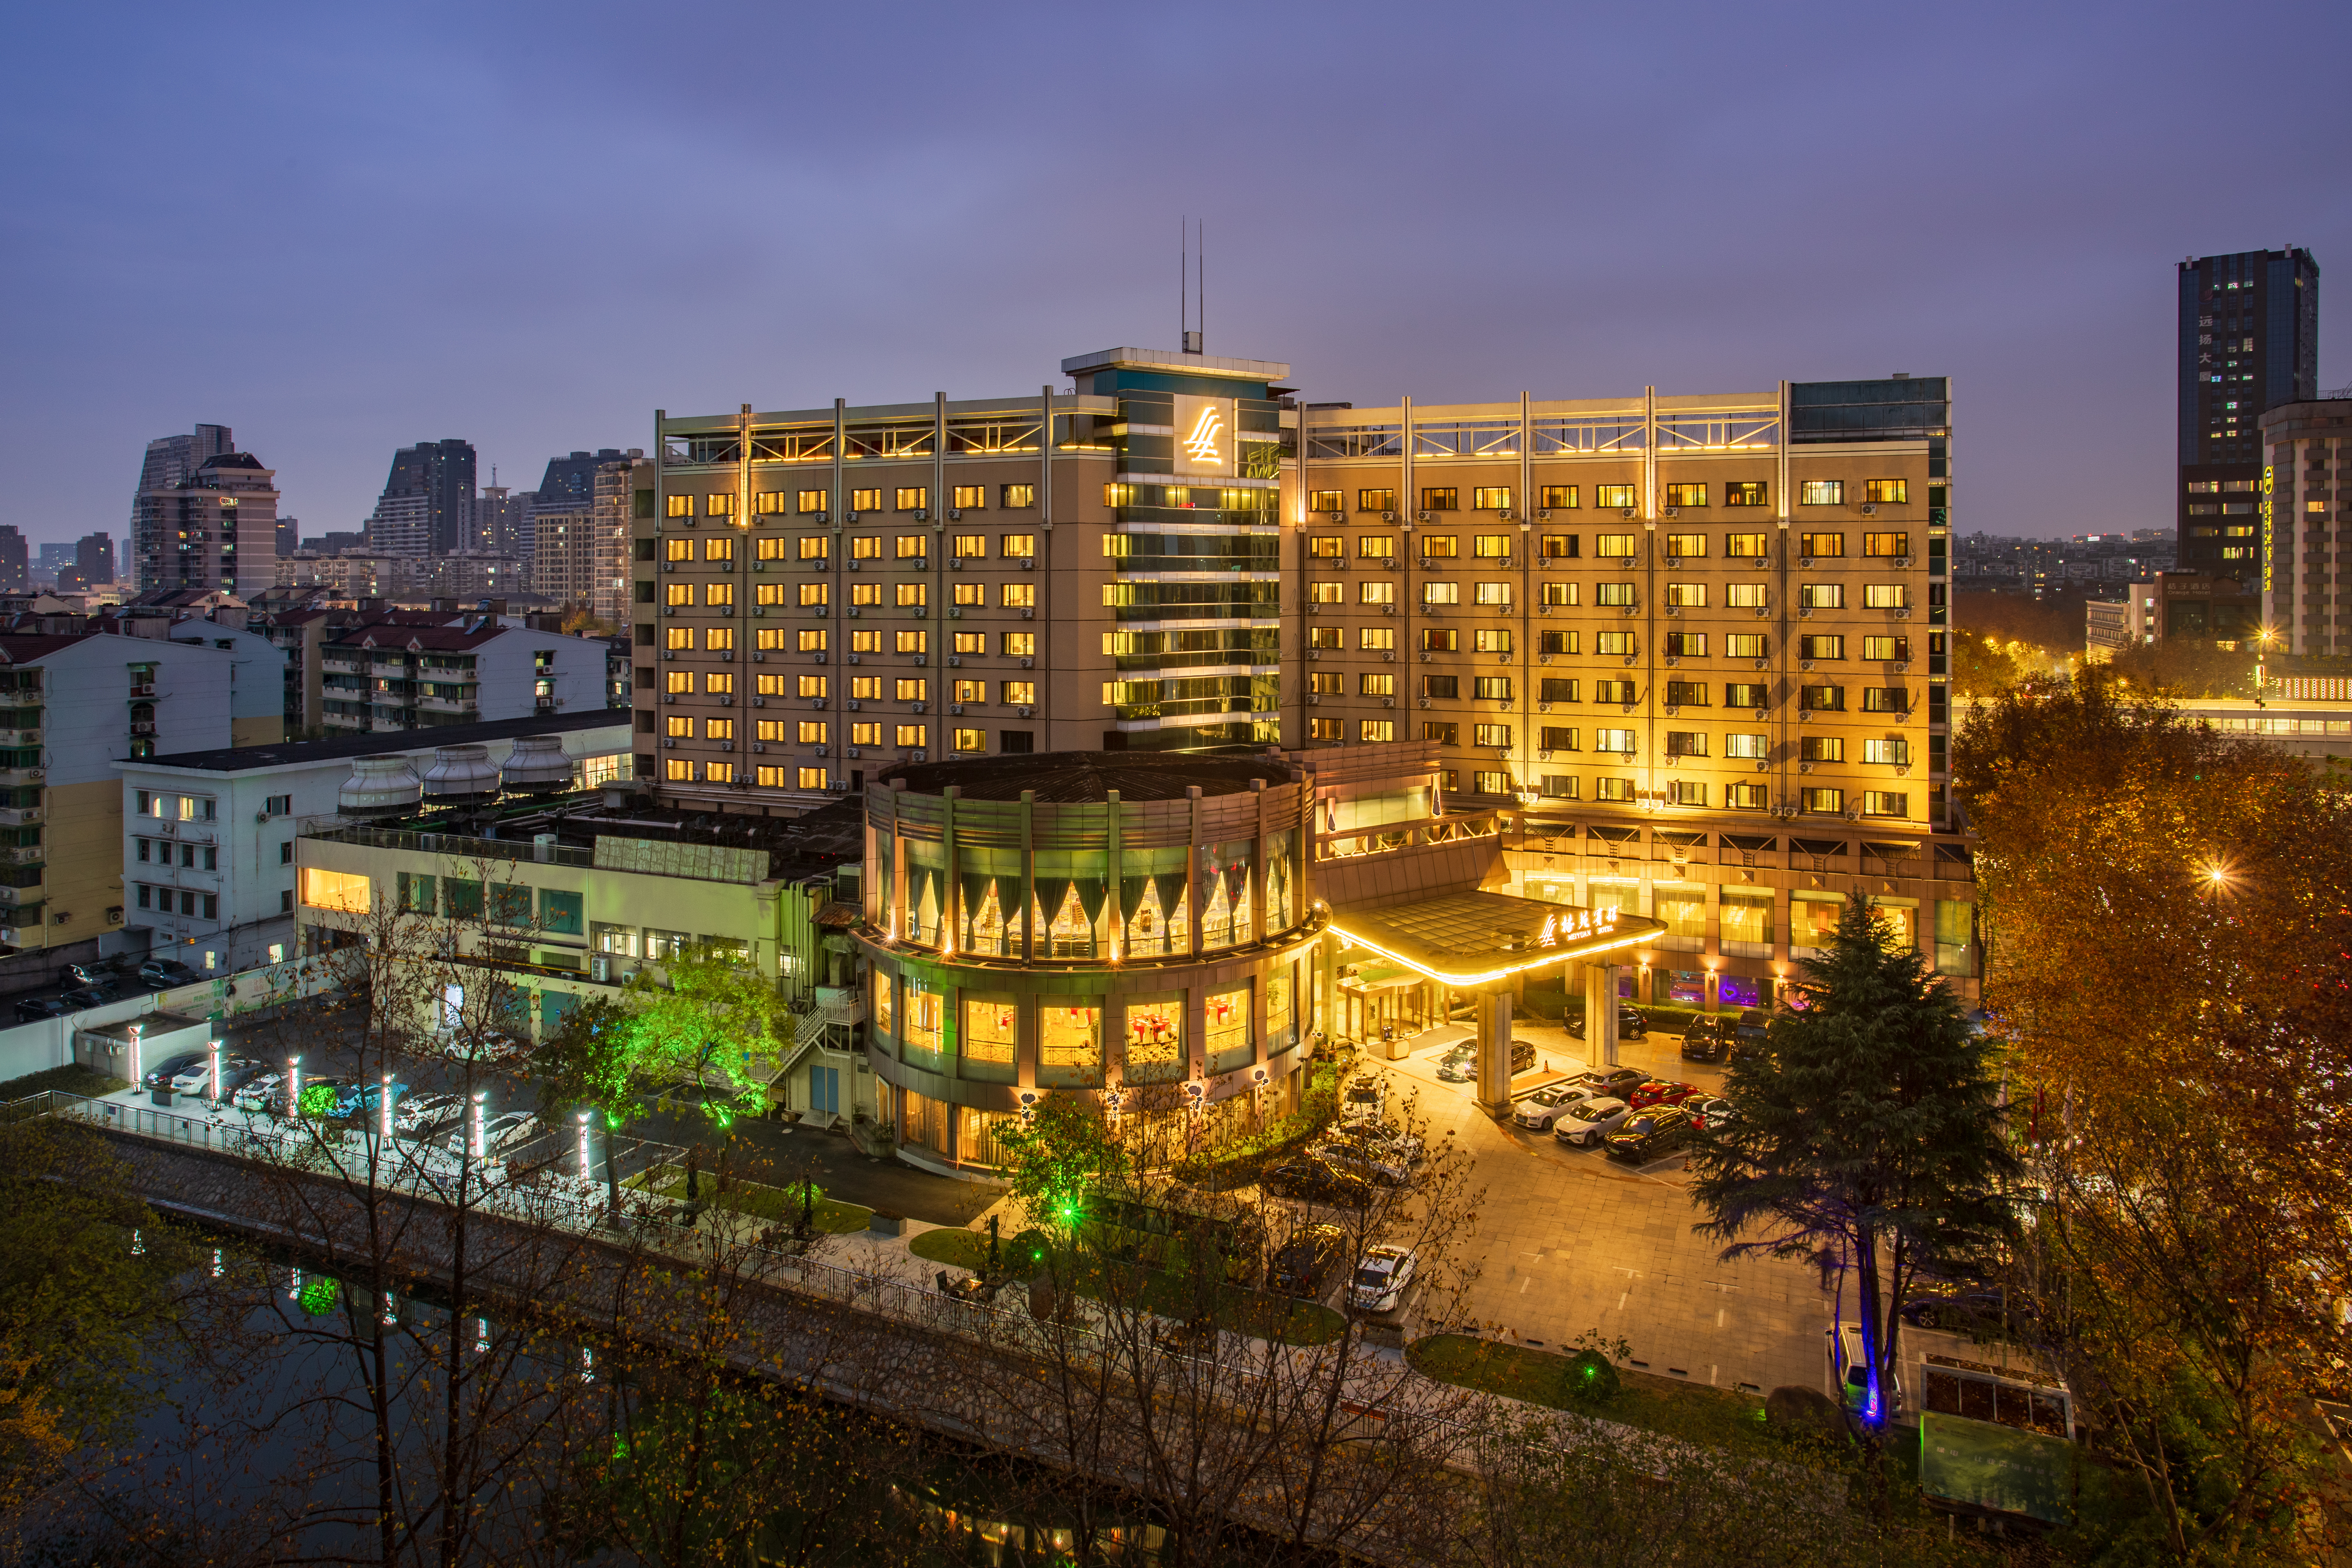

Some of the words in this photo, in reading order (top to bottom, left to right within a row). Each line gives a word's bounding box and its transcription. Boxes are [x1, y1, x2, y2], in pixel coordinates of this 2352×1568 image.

[2199, 316, 2212, 382] 远扬大厦
[1567, 929, 1591, 941] MEIYUAN
[1597, 925, 1614, 934] HOTEL
